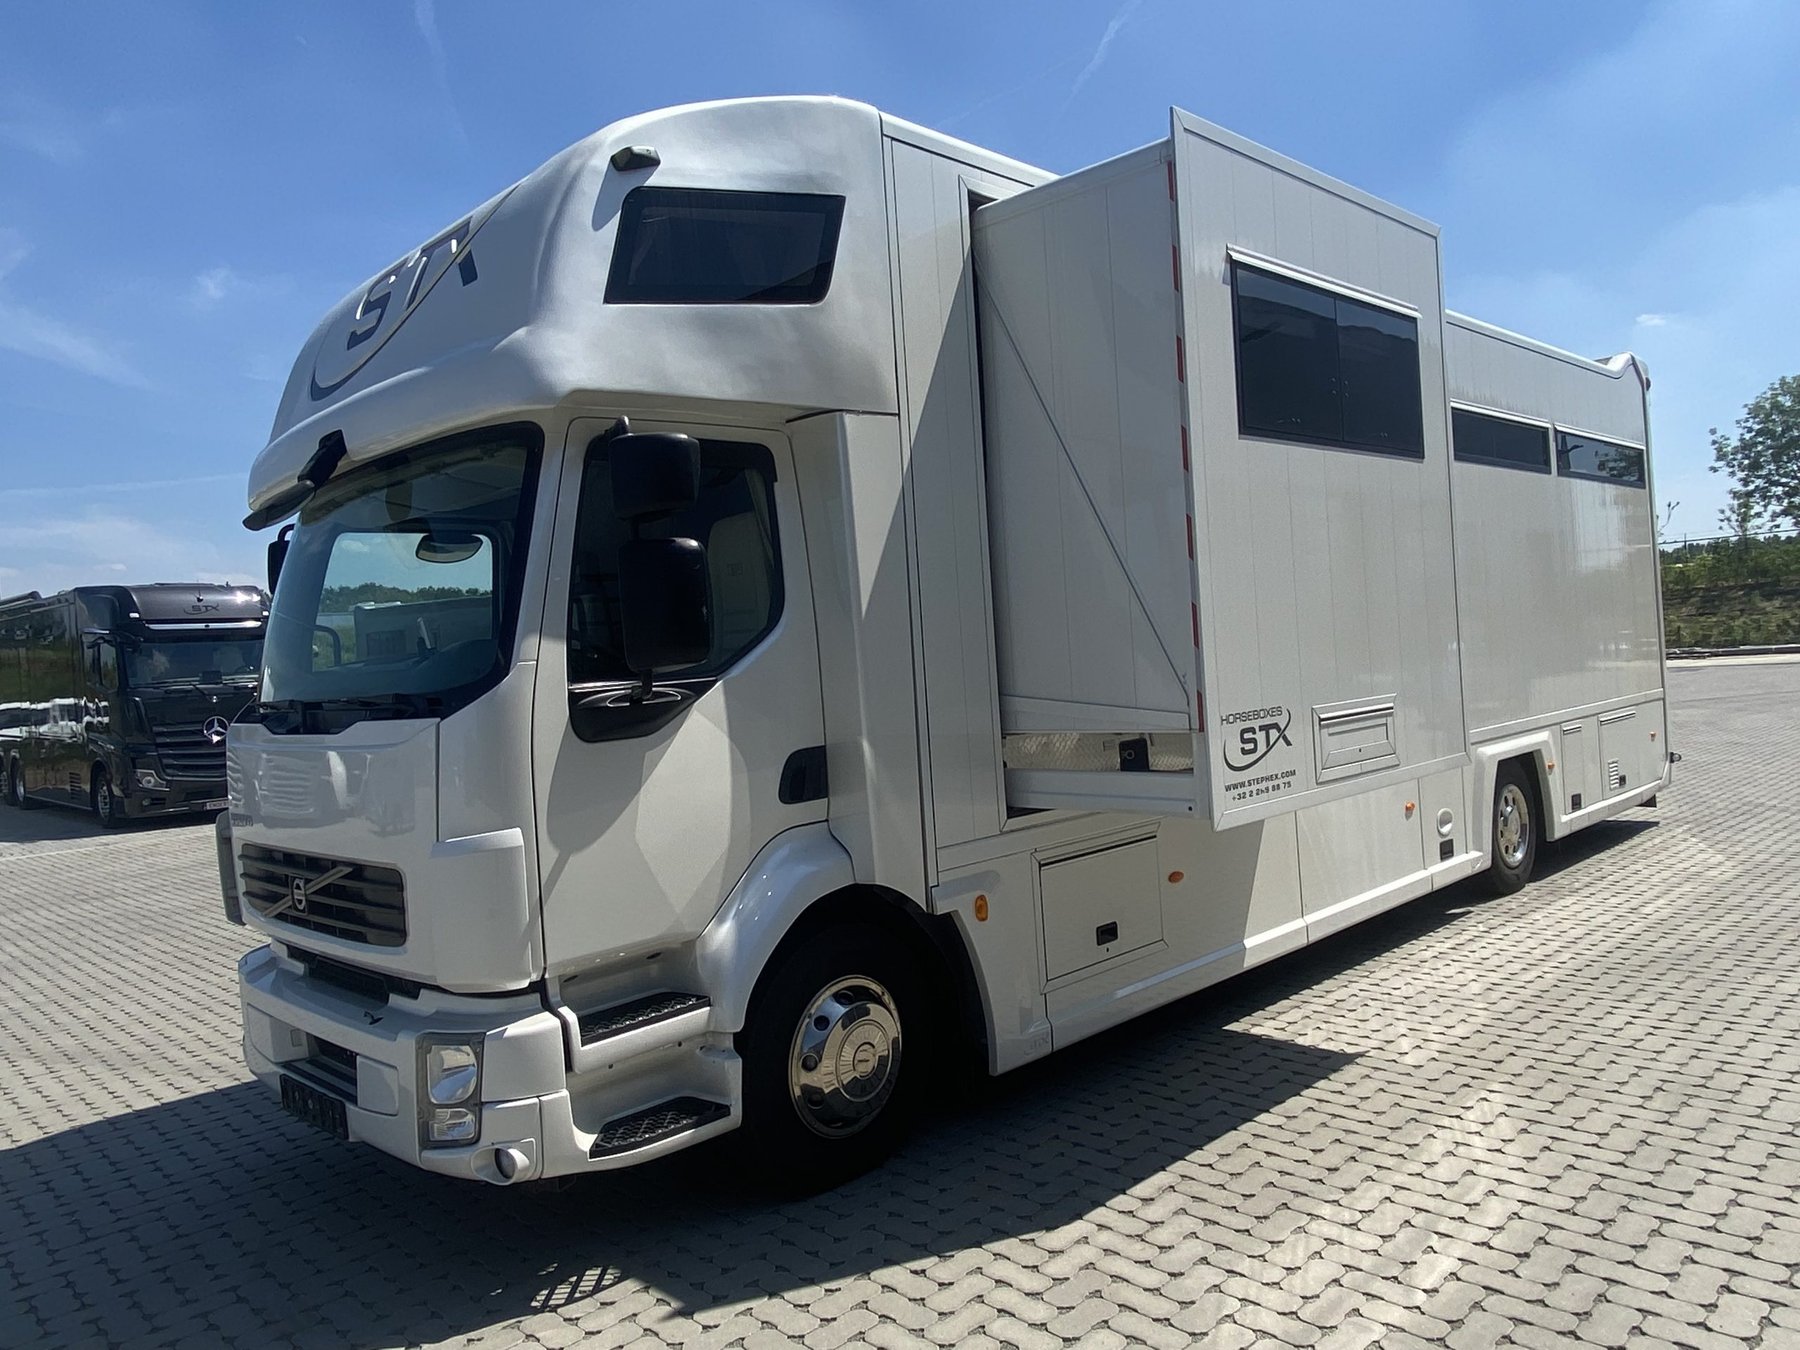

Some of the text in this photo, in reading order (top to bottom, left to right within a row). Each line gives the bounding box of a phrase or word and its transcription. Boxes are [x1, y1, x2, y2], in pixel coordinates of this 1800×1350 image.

[191, 604, 220, 612] STX
[1221, 706, 1283, 725] HORSEBOXES
[1239, 722, 1292, 755] STX
[1225, 769, 1296, 792] WWW.STEPHEX.COM
[1232, 792, 1246, 801] +32
